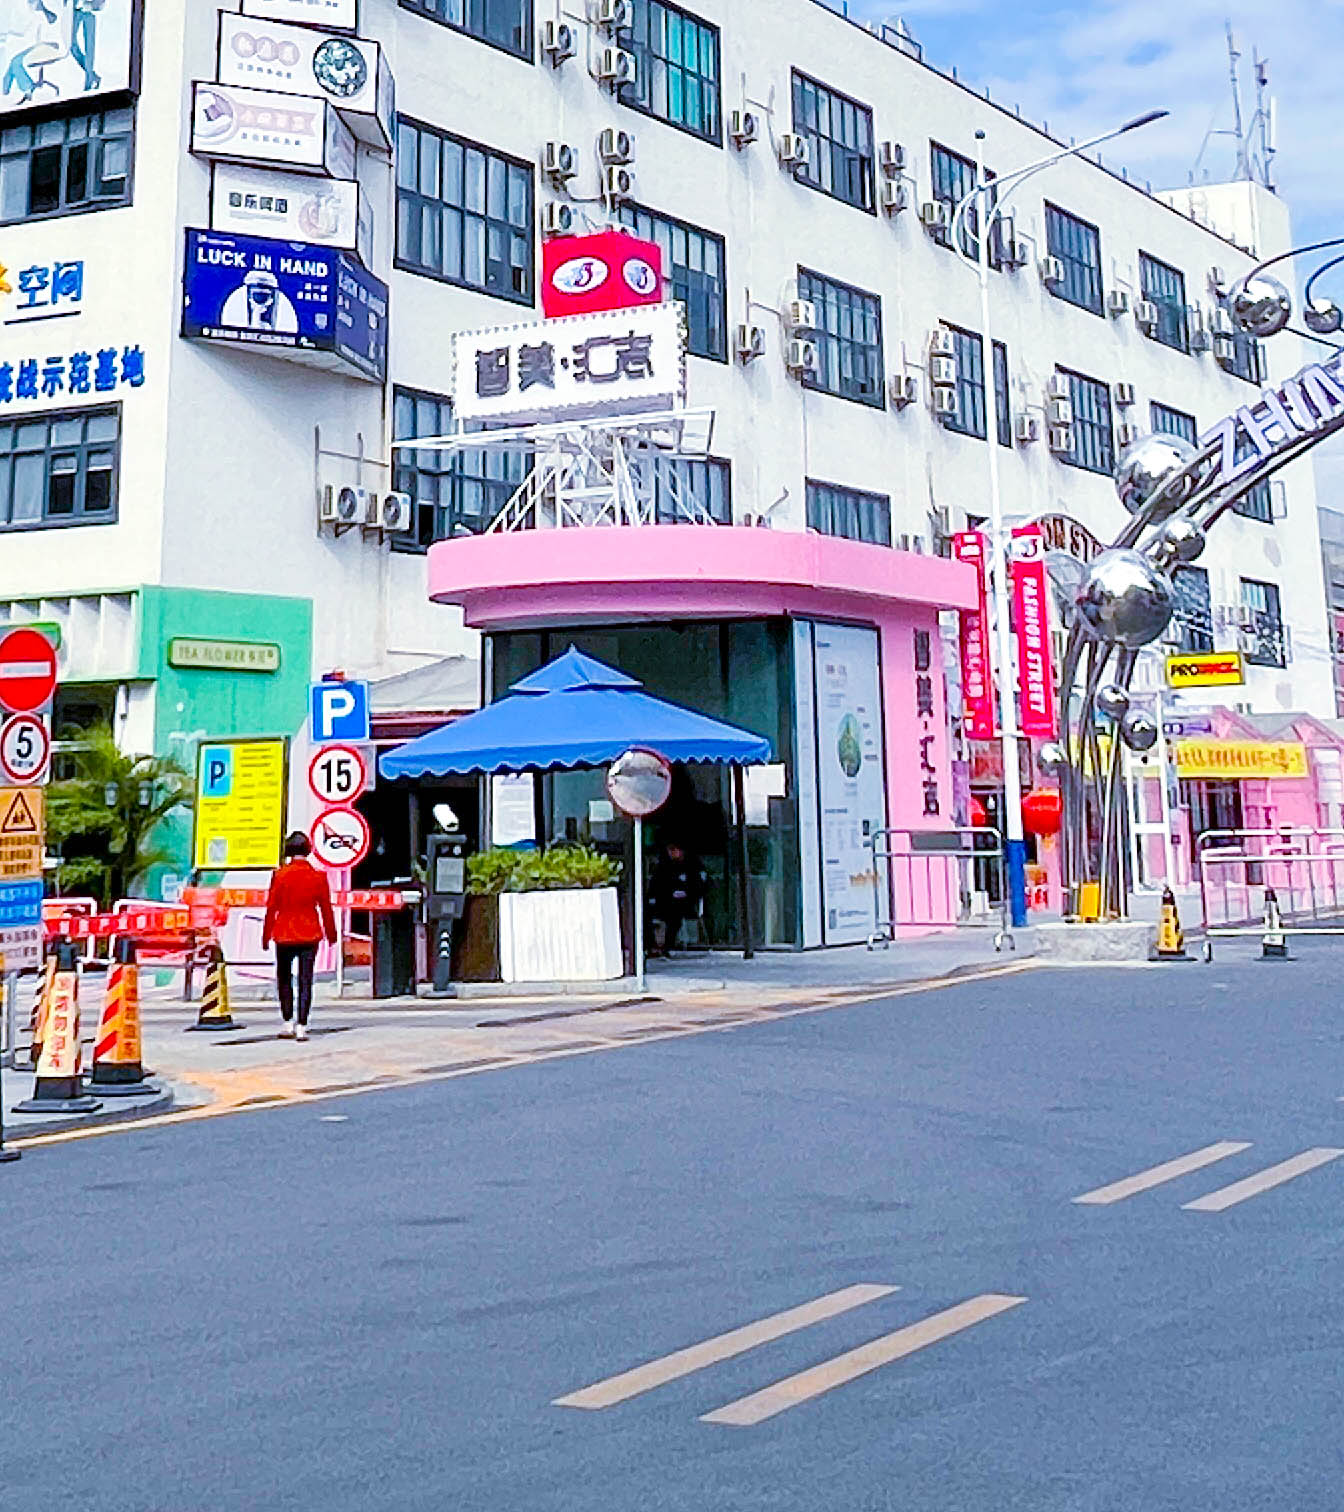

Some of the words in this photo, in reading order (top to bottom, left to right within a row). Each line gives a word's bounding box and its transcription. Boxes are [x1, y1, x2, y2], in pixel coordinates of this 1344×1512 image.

[197, 247, 248, 269] LUCK
[253, 253, 272, 271] IN
[280, 257, 329, 277] HAND
[1022, 576, 1042, 649] FASHION
[1027, 651, 1046, 714] STREET
[322, 690, 356, 736] P
[16, 726, 33, 759] 5
[210, 760, 226, 789] P
[321, 758, 353, 794] 15
